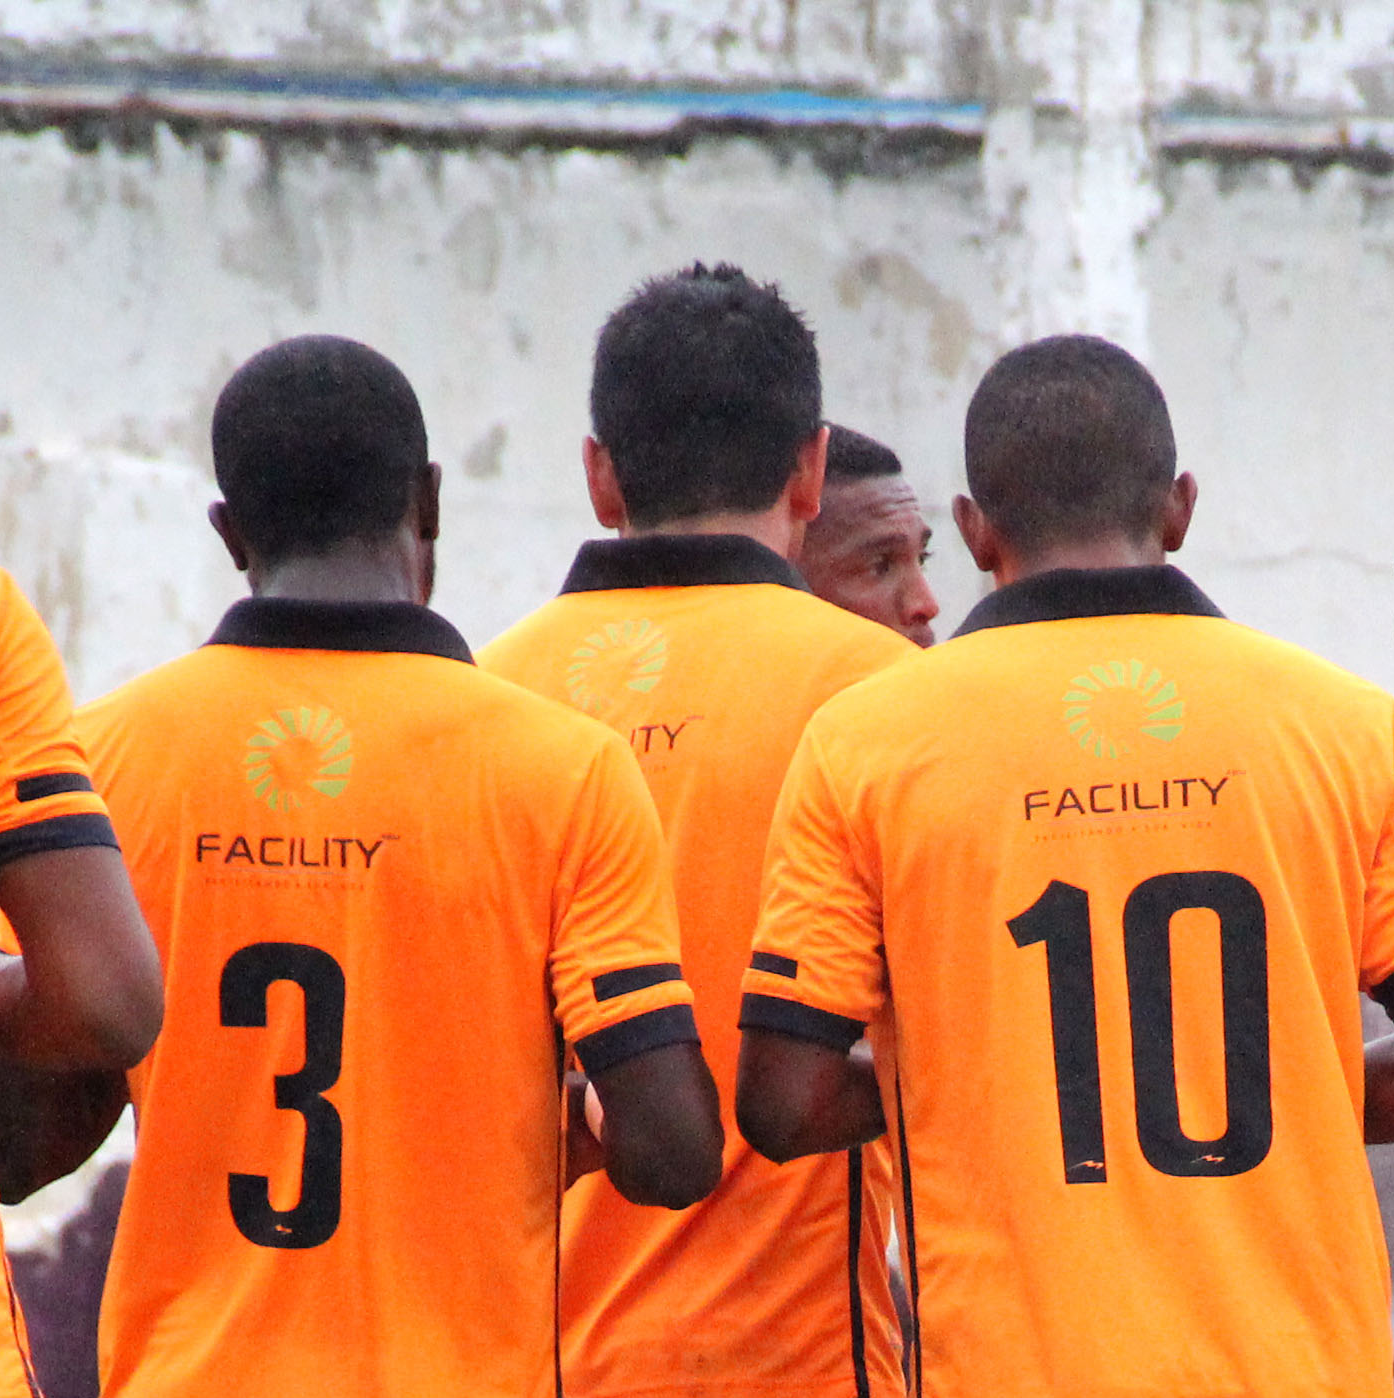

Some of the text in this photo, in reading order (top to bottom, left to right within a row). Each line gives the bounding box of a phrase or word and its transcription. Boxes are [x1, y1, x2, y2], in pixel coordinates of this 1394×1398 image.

[196, 833, 383, 868] FACILITY
[1024, 777, 1228, 820] FACILITY
[219, 942, 345, 1250] 3
[1005, 870, 1273, 1184] 10
